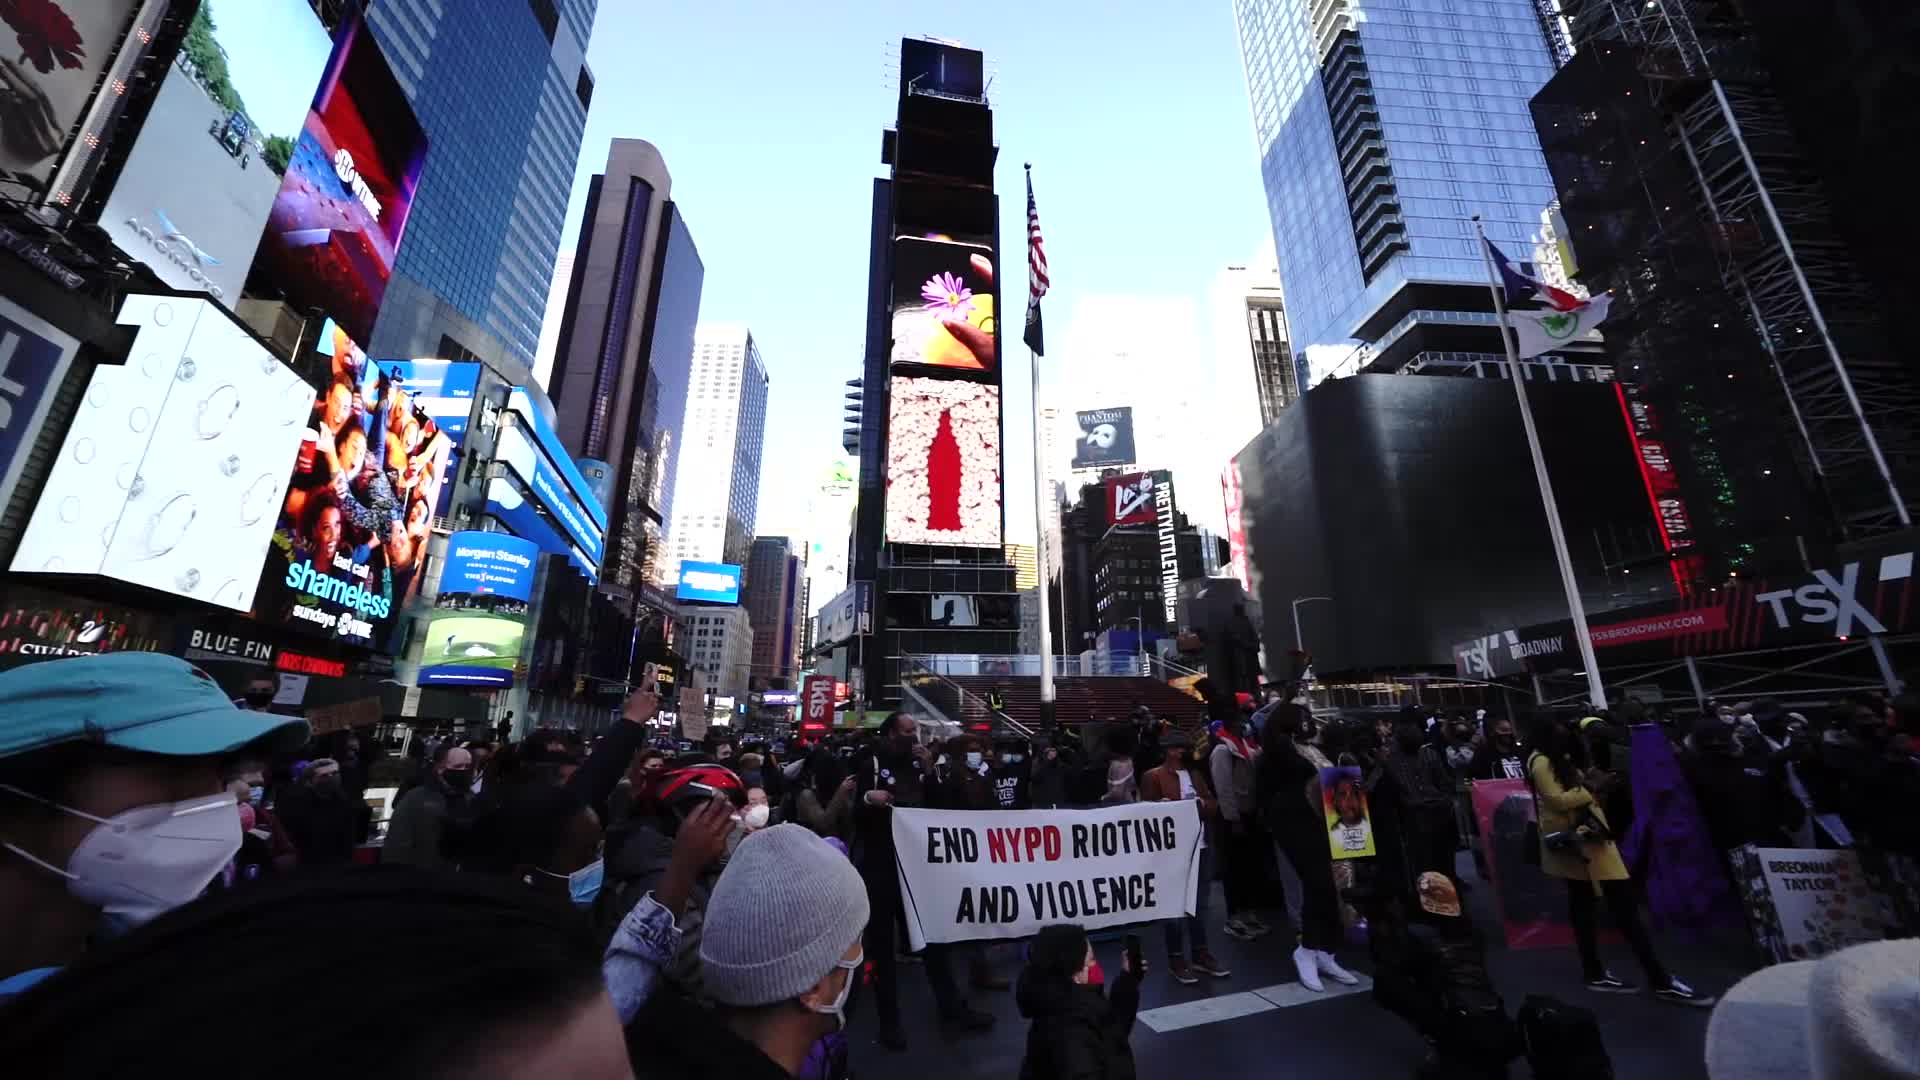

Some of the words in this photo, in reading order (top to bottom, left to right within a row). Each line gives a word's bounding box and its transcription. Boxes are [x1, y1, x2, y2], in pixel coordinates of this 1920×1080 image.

[333, 552, 353, 572] last
[352, 563, 370, 579] call
[455, 547, 496, 560] Morgan
[496, 550, 531, 569] Stanley
[1155, 481, 1180, 623] PRETTYLITTLETHING.COM
[286, 559, 391, 619] shameless
[1755, 562, 1888, 638] TSX
[292, 604, 337, 629] sundays
[190, 629, 238, 654] BLUE
[244, 640, 272, 660] FIN
[1459, 638, 1496, 680] TSX
[809, 679, 832, 718] tkts
[926, 826, 979, 864] END
[986, 824, 1062, 864] NYPD
[1071, 815, 1177, 859] RIOTING
[955, 884, 1020, 925] AND
[1026, 872, 1157, 921] VIOLENCE
